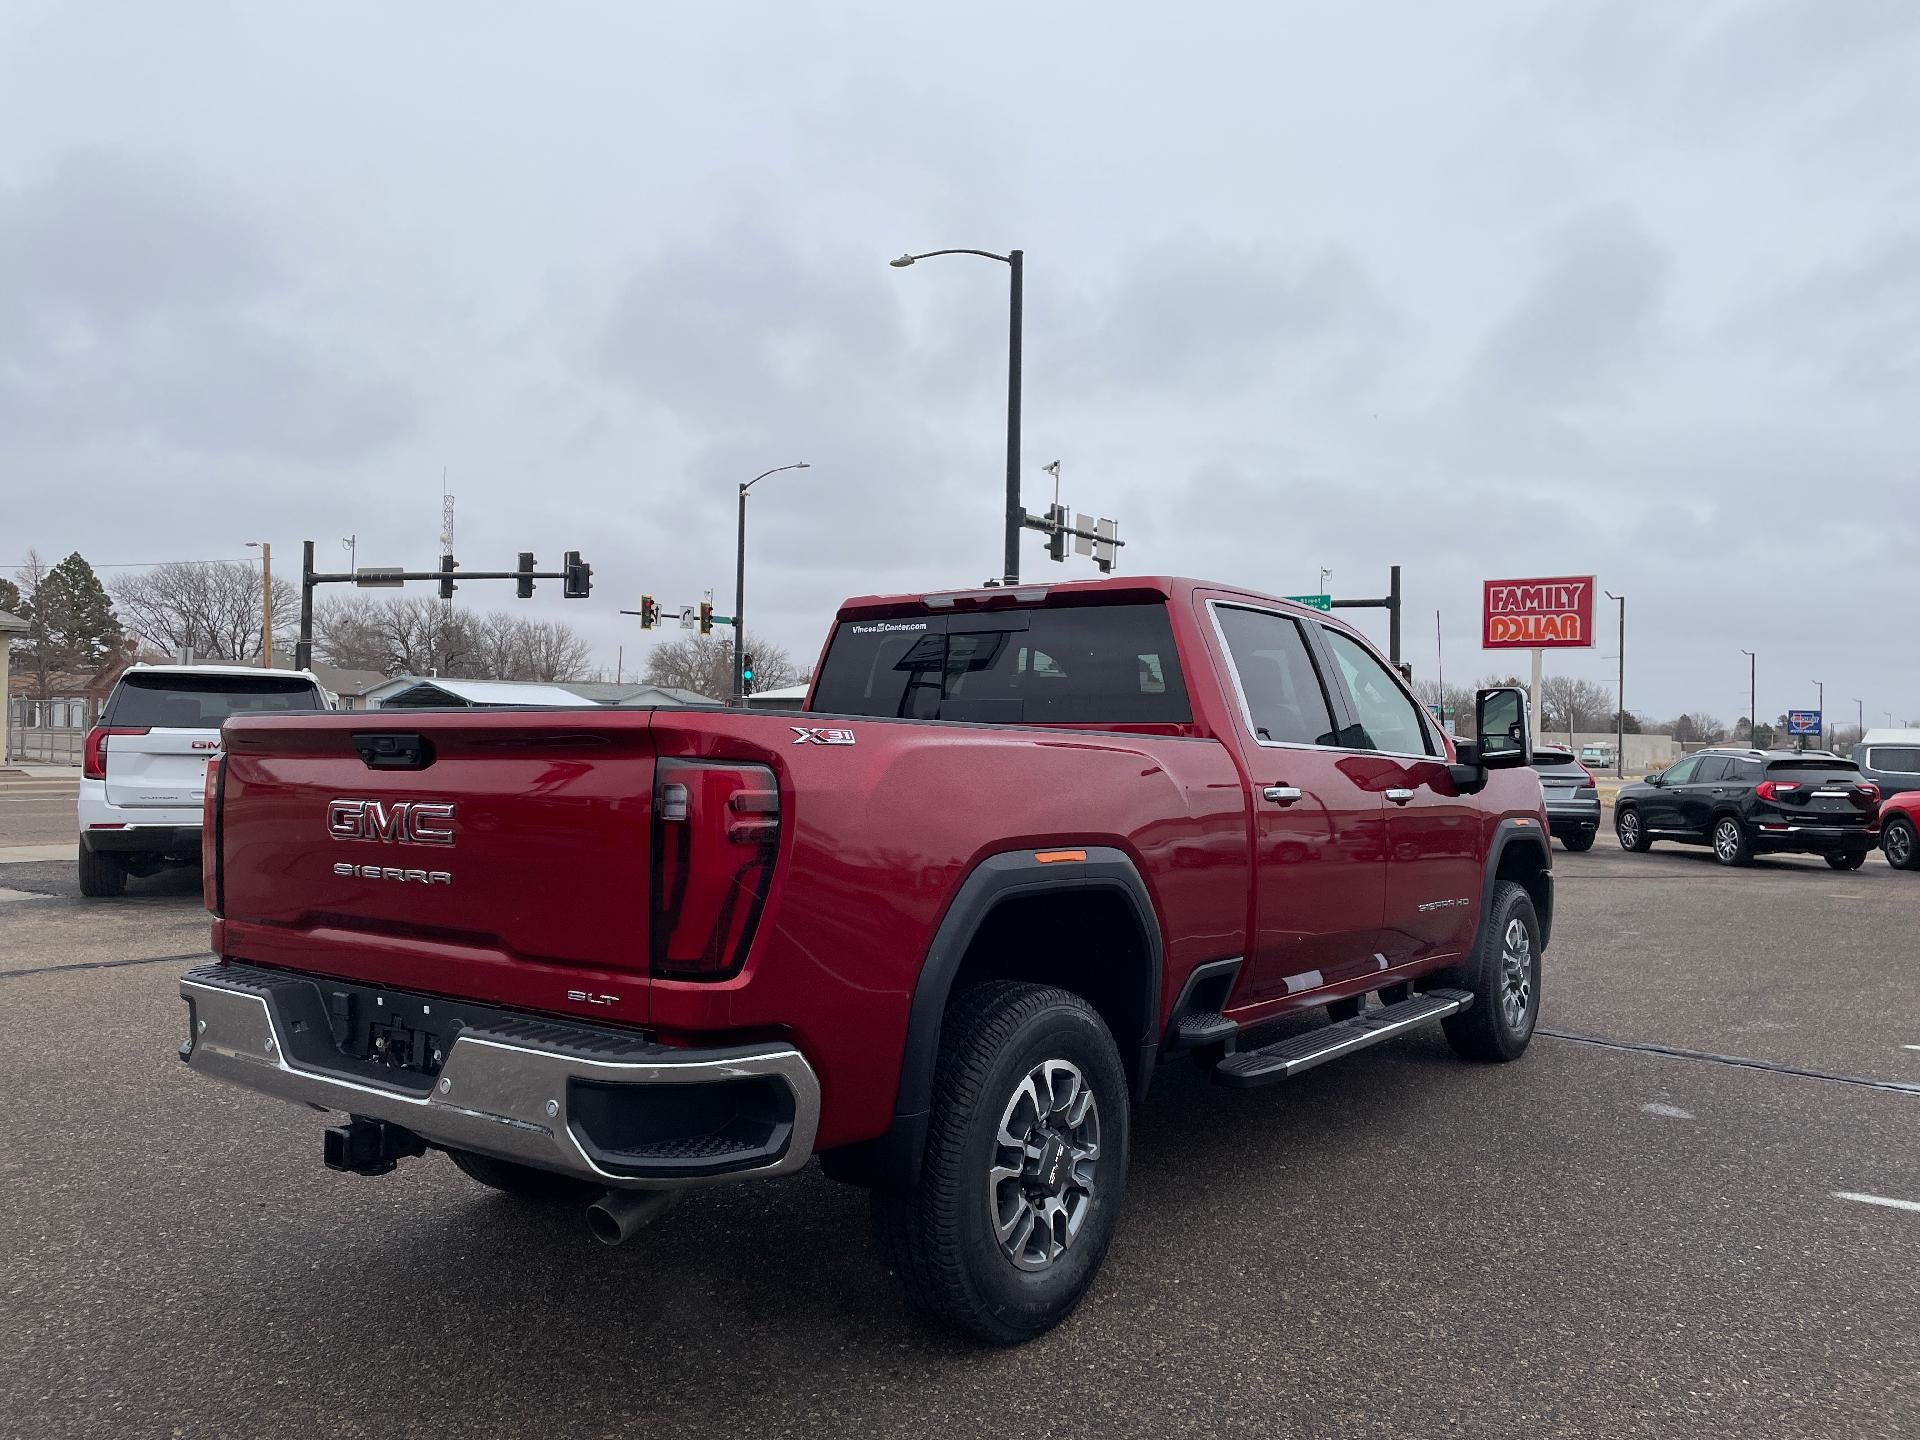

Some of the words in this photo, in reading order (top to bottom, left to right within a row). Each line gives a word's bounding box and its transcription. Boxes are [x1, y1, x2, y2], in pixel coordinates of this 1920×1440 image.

[1490, 583, 1584, 612] FAMILY
[1490, 613, 1580, 641] DOLLAR
[790, 726, 856, 744] X31
[327, 799, 455, 847] GMC
[333, 863, 452, 884] SIERRA
[1418, 900, 1454, 911] SIERRA
[567, 990, 620, 1005] SLT
